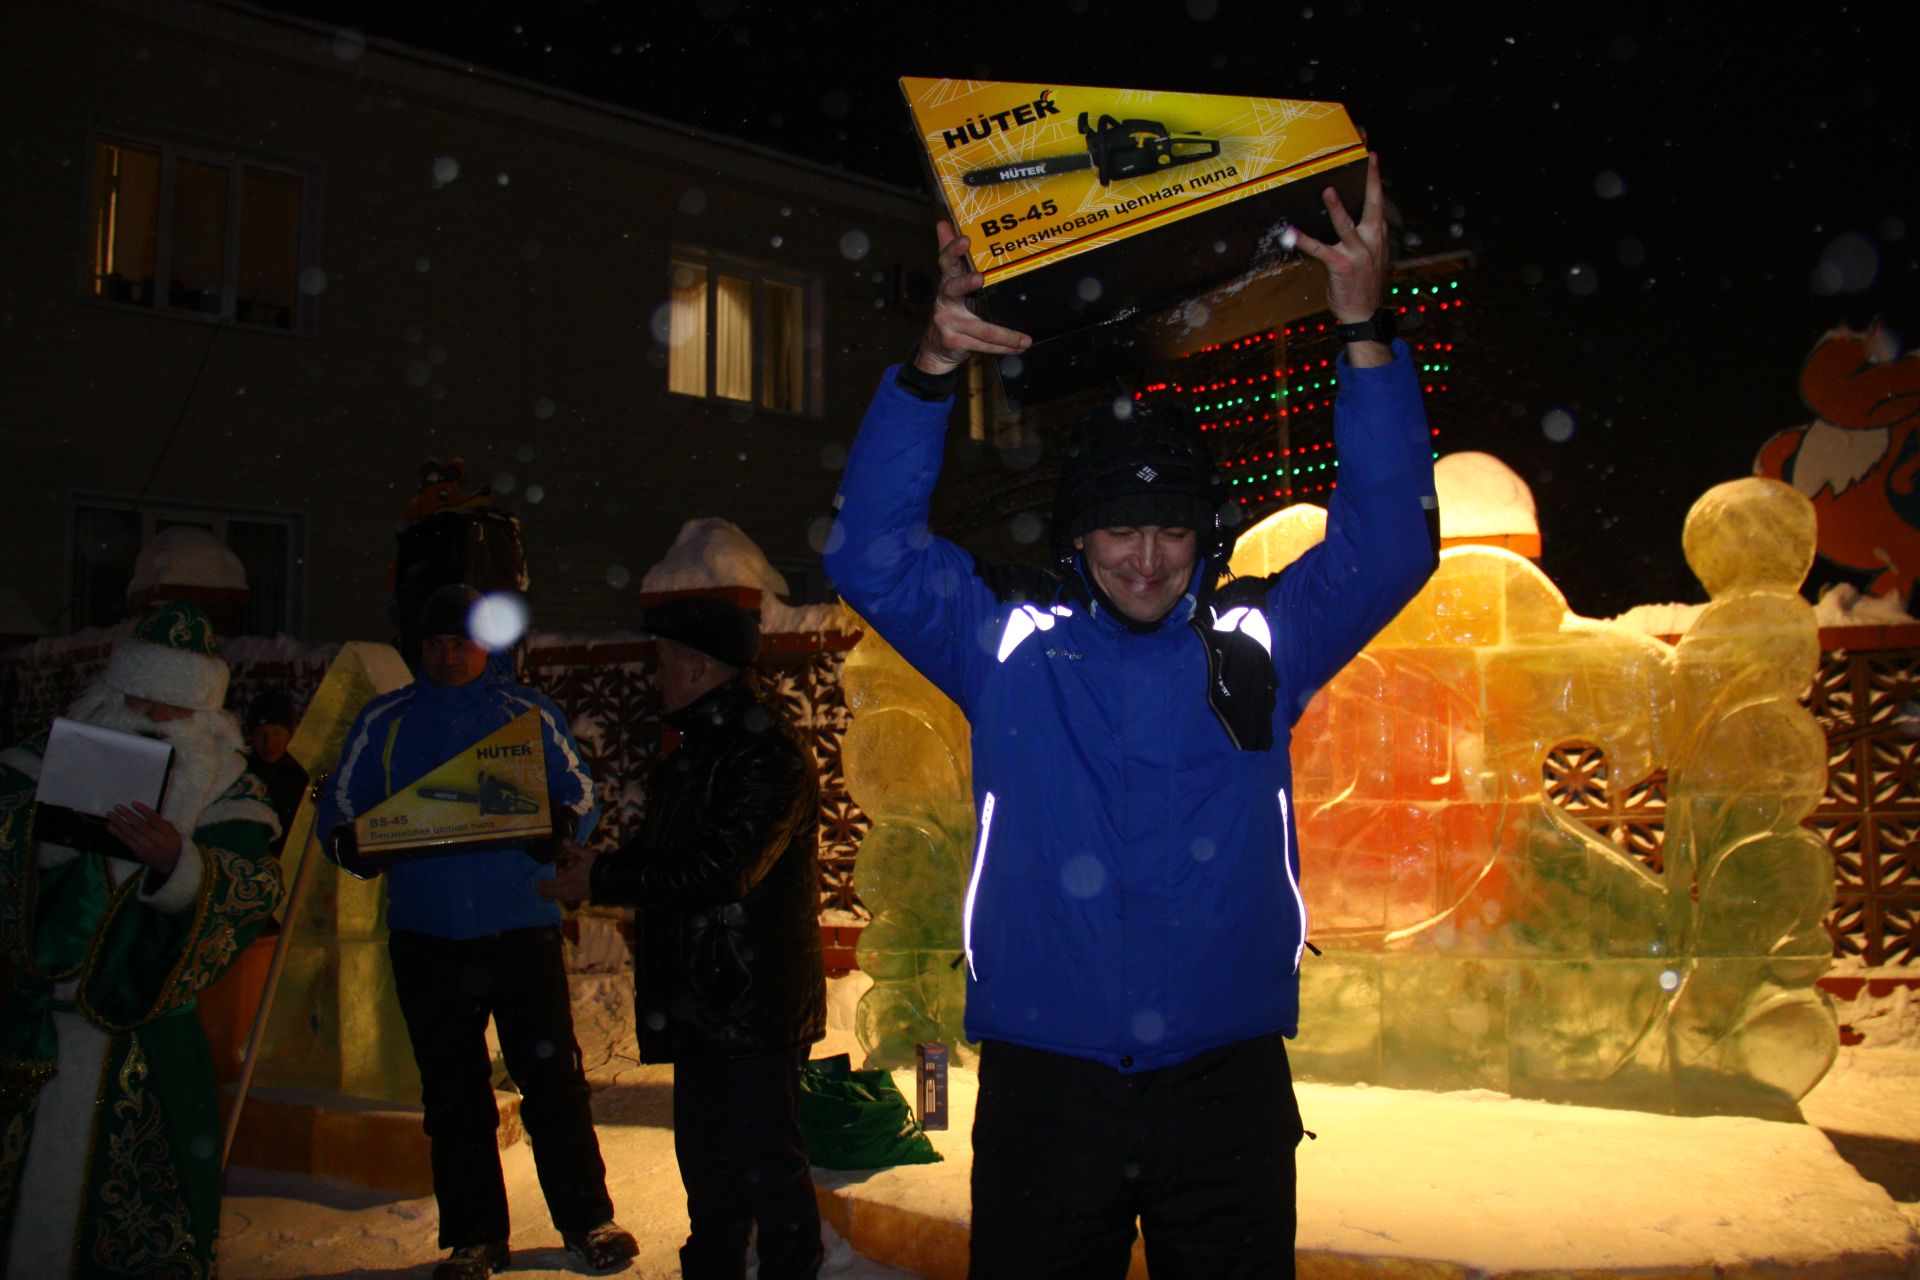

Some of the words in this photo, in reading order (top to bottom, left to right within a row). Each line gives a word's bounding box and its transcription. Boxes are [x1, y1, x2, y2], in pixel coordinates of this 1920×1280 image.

[943, 92, 1060, 149] HÜTER
[1000, 163, 1046, 180] HÜTER
[981, 200, 1058, 237] BS-45
[989, 209, 1109, 257] Бензиновая
[1115, 183, 1185, 214] цепная
[1189, 164, 1237, 188] пила
[476, 743, 533, 760] HÜTER
[369, 815, 409, 828] BS-45
[370, 827, 431, 840] Бензиновая
[433, 823, 469, 834] цепная
[471, 821, 495, 829] пила
